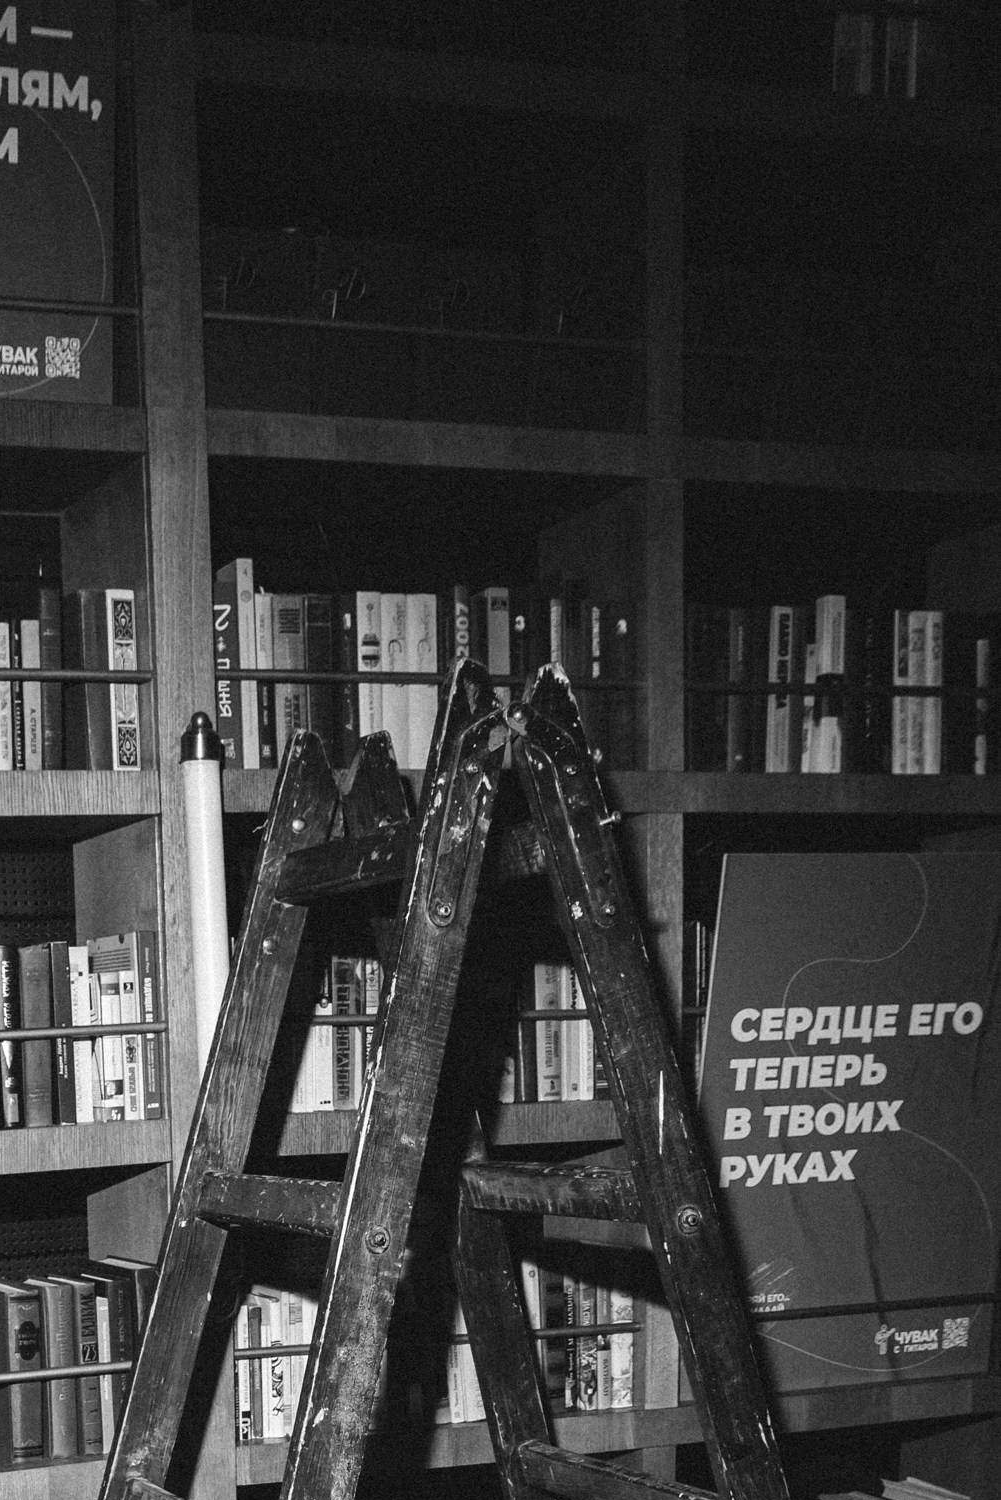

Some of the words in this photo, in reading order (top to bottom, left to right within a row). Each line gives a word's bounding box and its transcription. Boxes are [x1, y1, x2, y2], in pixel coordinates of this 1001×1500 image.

[456, 602, 469, 657] 2007
[1, 960, 12, 998] КРИСТИ
[3, 1002, 12, 1029] АГАТА
[729, 1005, 899, 1046] СЕРДЦЕ
[908, 1002, 984, 1037] ЕГО
[729, 1054, 888, 1092] ТЕПЕРЬ
[723, 1106, 751, 1141] В
[763, 1099, 904, 1139] ТВОИХ
[719, 1149, 859, 1189] РУКАХ
[80, 1292, 95, 1338] БАЛЬЗАК
[83, 1343, 97, 1362] 23
[894, 1328, 939, 1346] ЧУВАК
[903, 1342, 939, 1353] ГИТАРОЙ
